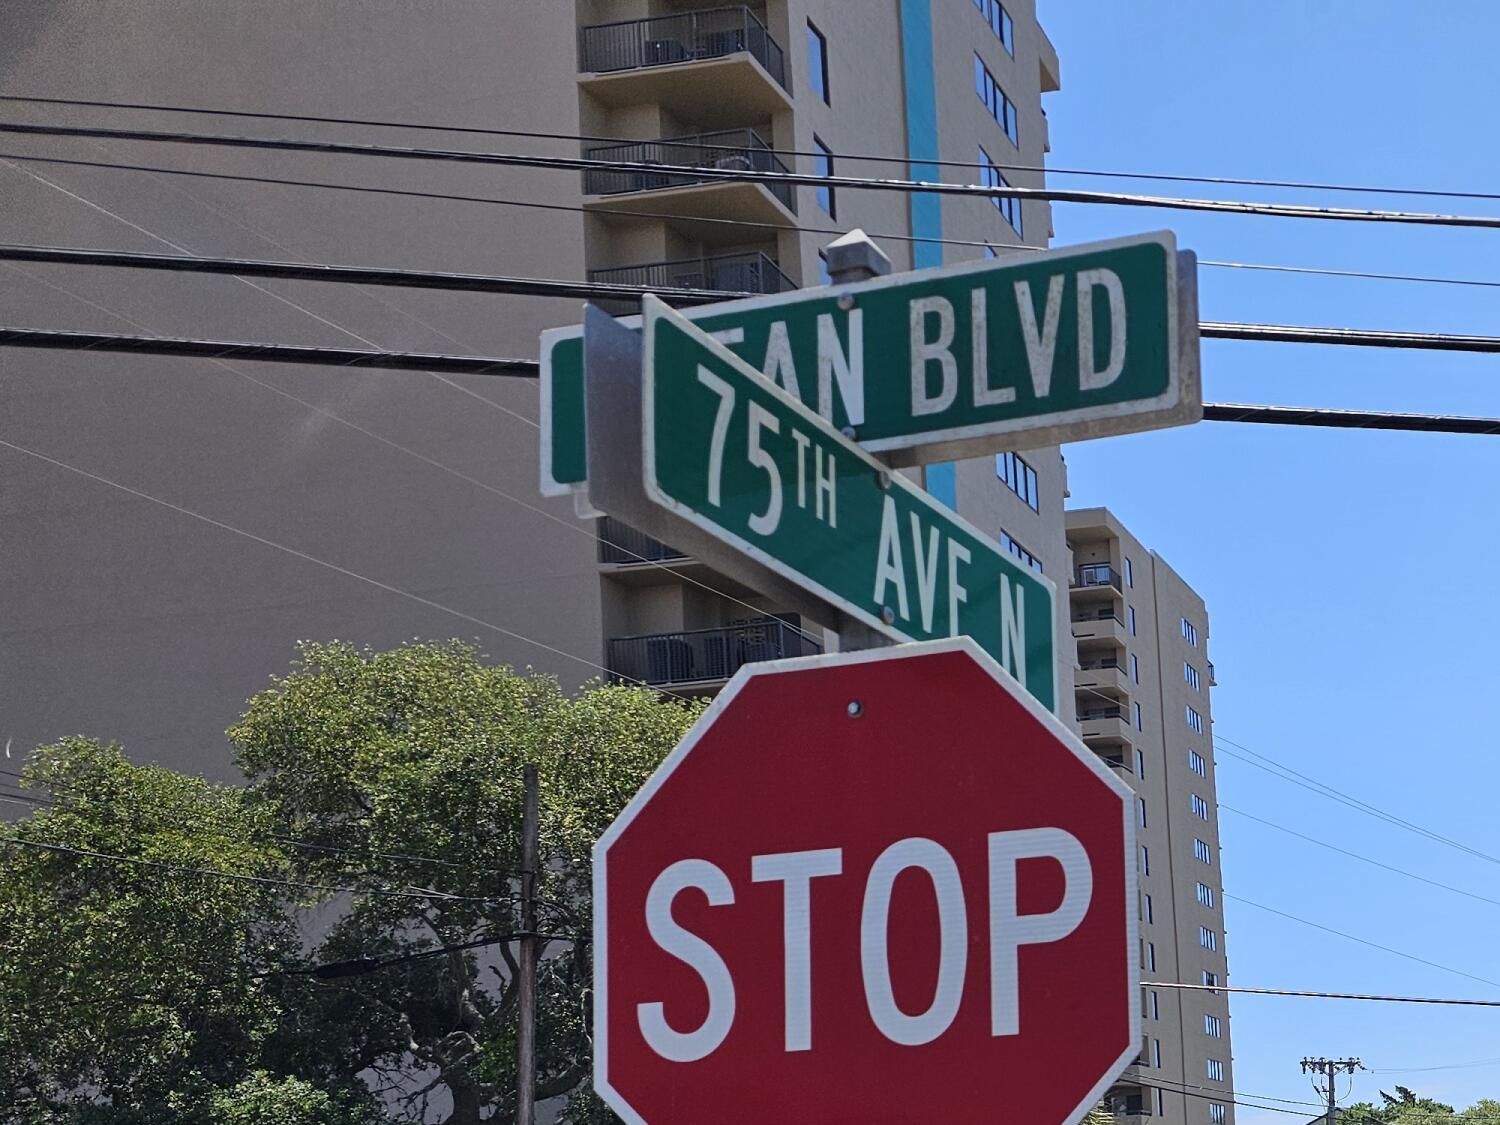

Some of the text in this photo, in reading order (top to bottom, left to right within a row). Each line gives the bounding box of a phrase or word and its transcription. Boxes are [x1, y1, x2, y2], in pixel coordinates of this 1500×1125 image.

[909, 268, 1128, 417] BLVD
[696, 362, 1027, 690] 75TH AVE N
[636, 826, 1094, 1063] STOP
